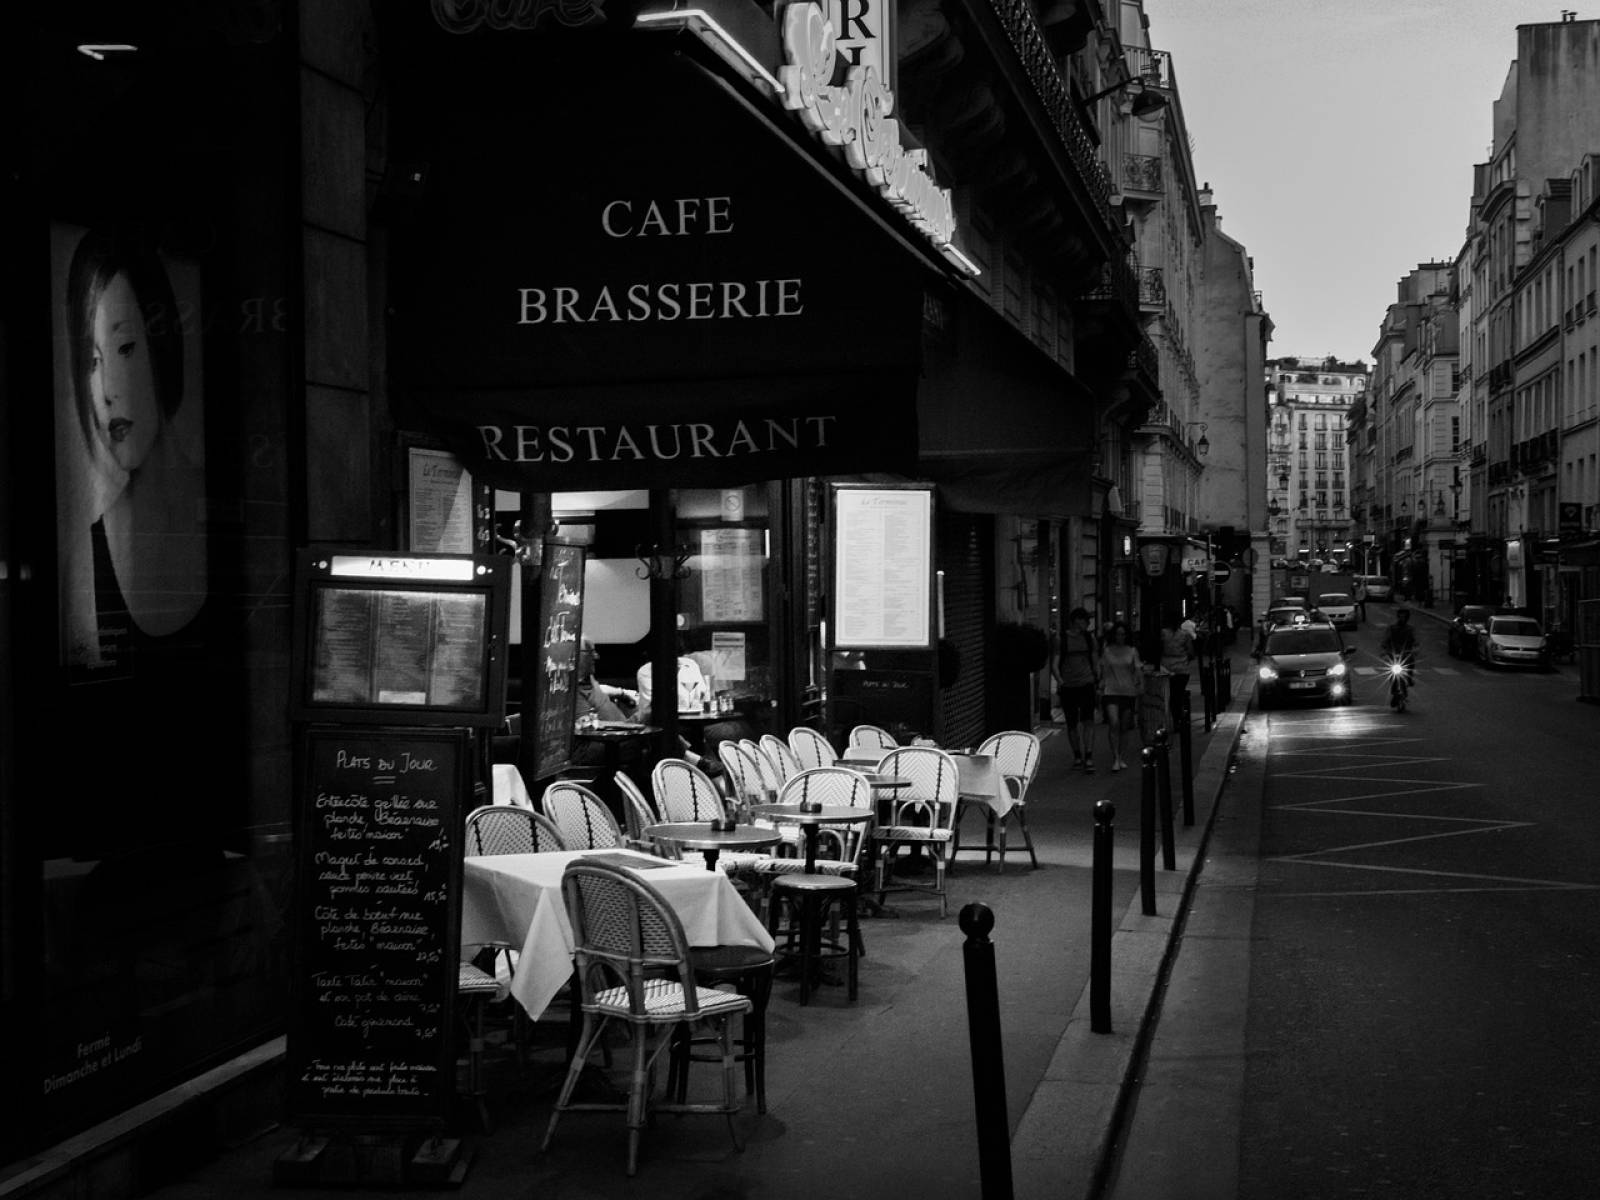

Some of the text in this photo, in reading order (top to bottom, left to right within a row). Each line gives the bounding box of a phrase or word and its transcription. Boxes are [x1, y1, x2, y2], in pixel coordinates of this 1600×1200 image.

[601, 196, 735, 238] CAFE
[517, 278, 804, 325] BRASSERIE
[478, 416, 835, 463] RESTAURANT
[43, 1034, 143, 1096] Dimanche et Lundi
[77, 1031, 111, 1059] Fermé
